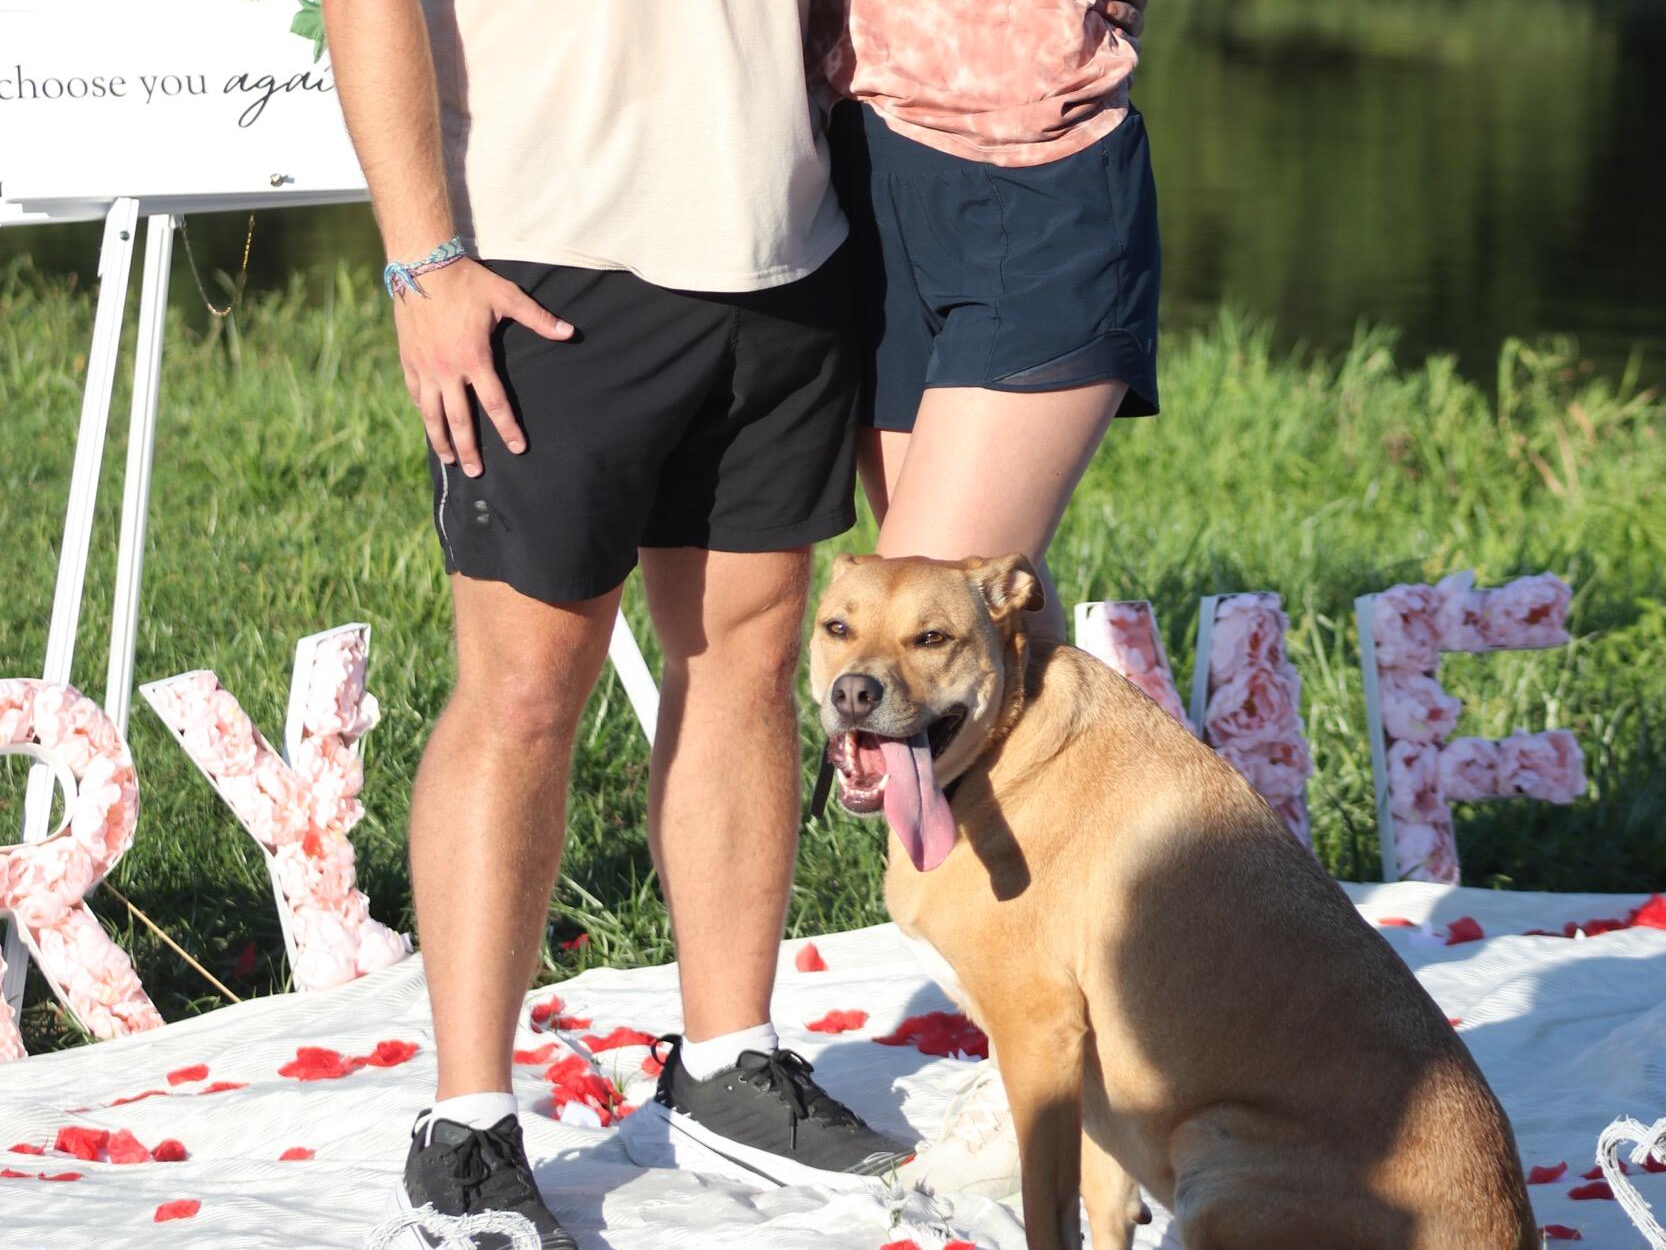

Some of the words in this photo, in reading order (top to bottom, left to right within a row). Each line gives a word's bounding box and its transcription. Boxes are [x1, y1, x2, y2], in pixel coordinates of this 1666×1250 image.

[0, 65, 128, 100] choose
[139, 74, 208, 104] you
[222, 65, 337, 128] agai
